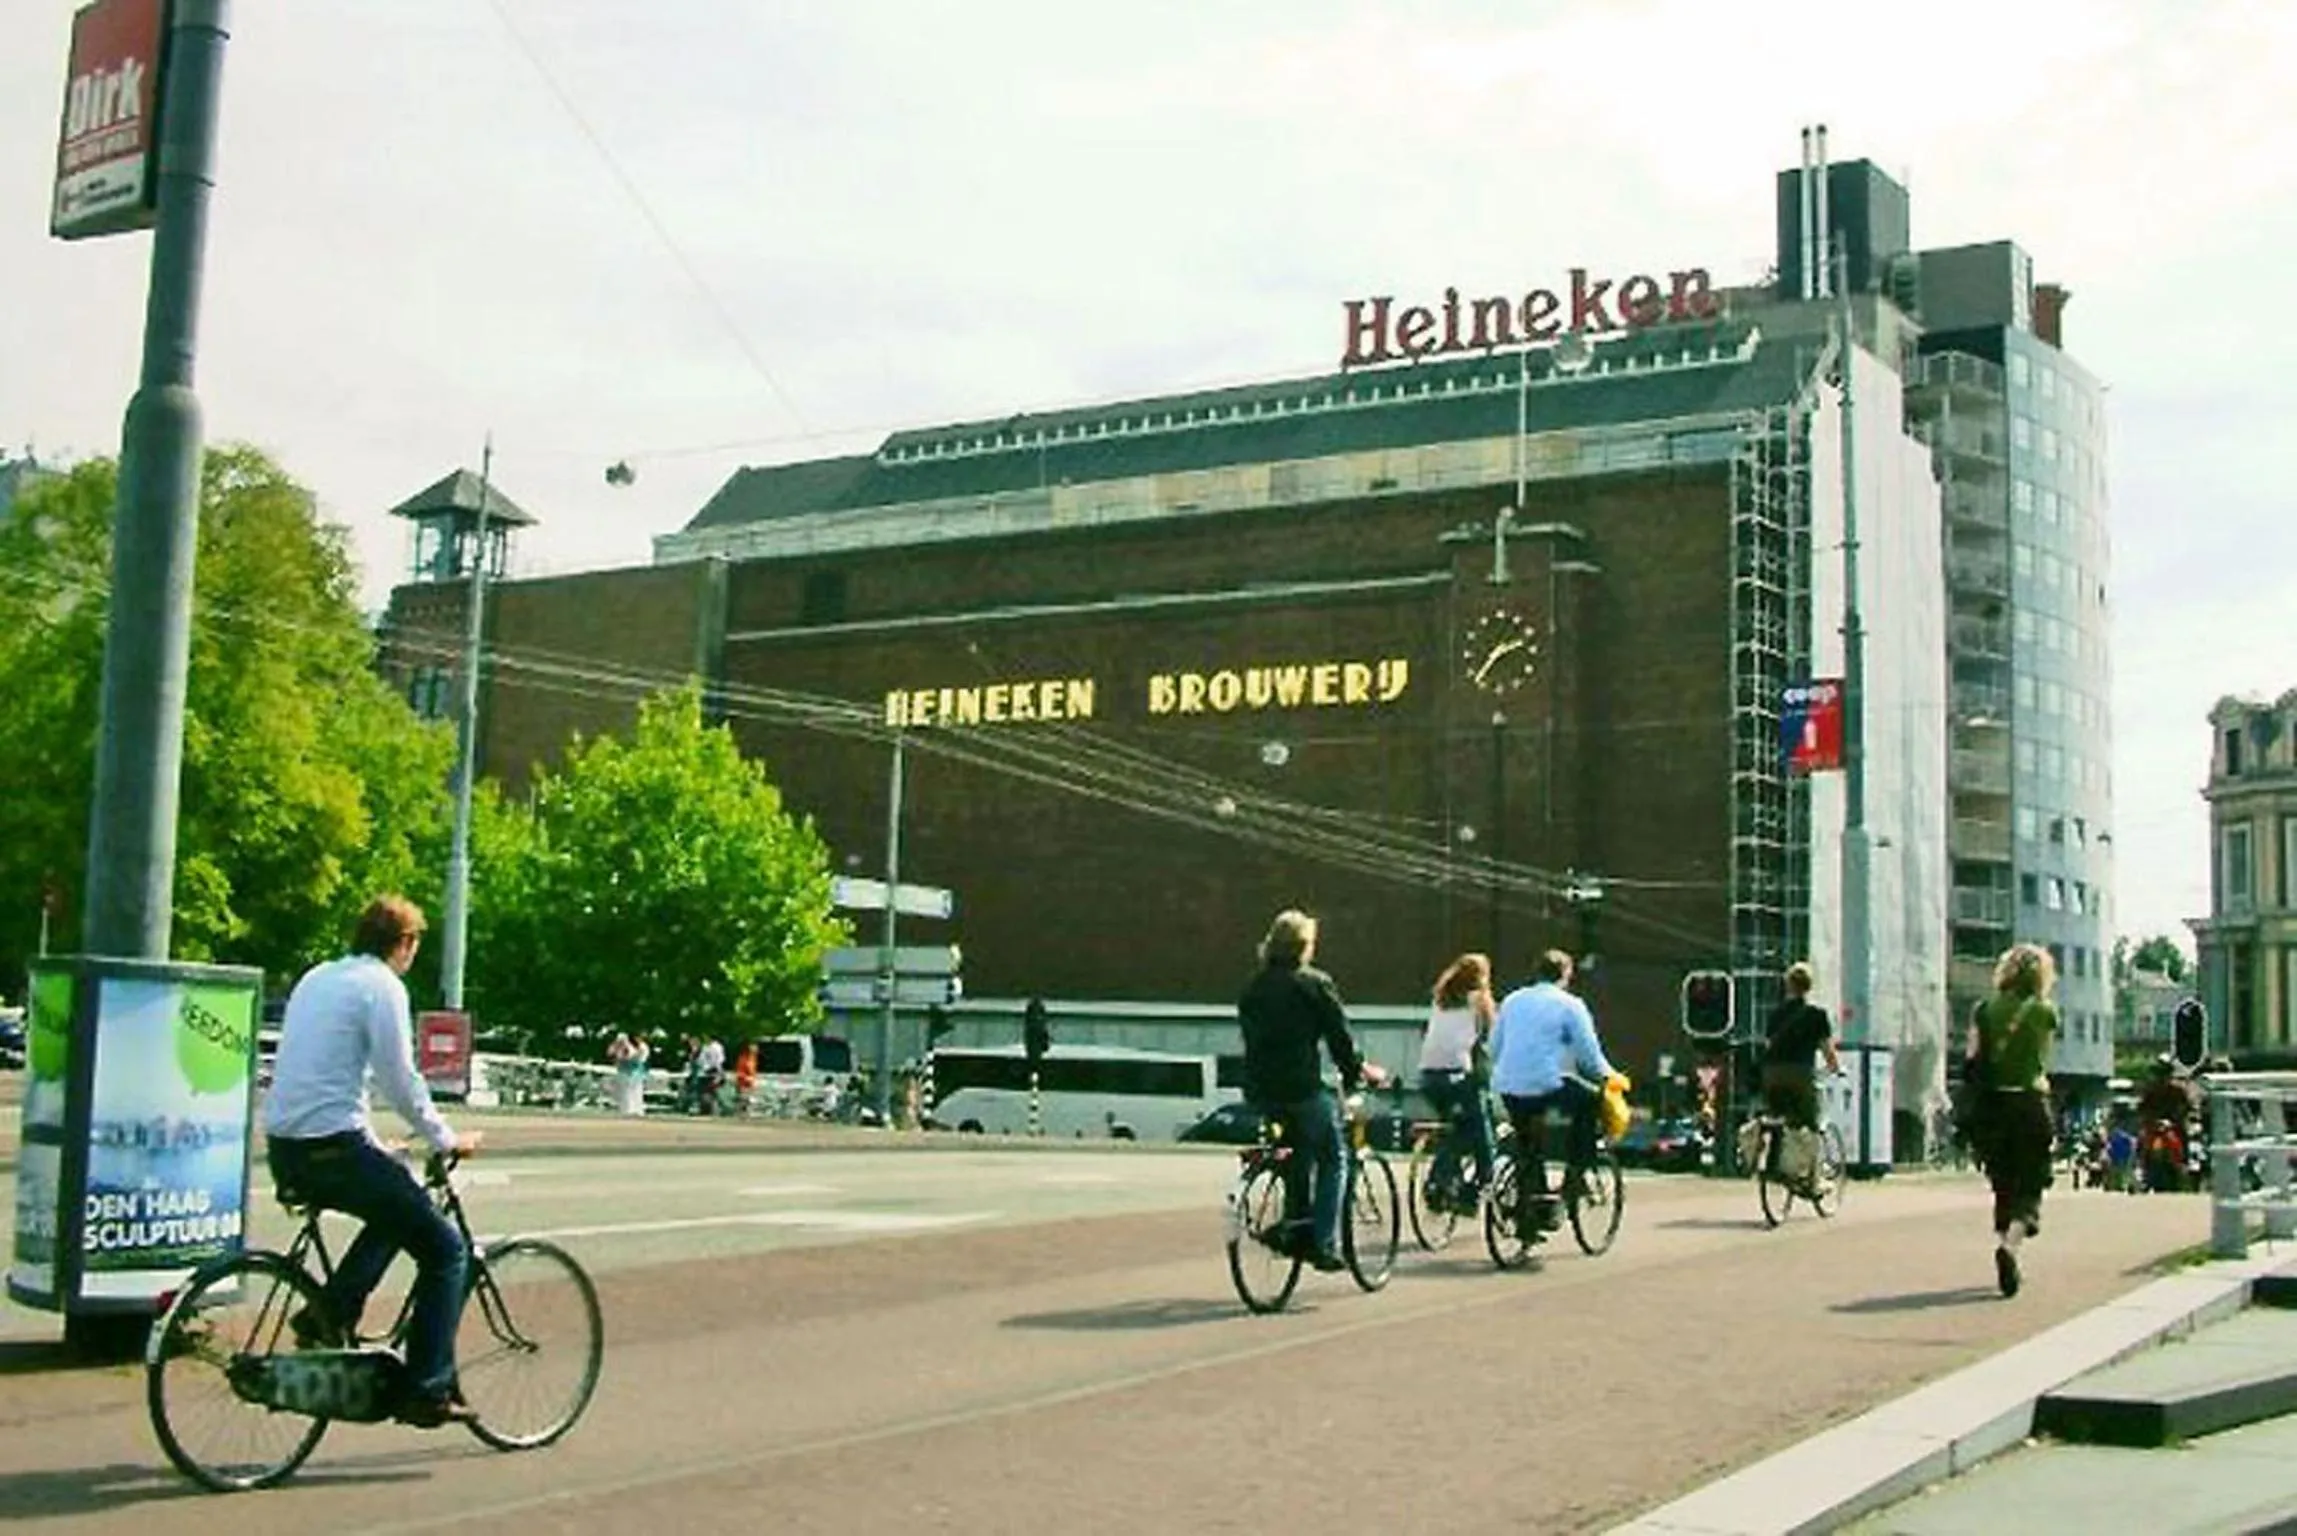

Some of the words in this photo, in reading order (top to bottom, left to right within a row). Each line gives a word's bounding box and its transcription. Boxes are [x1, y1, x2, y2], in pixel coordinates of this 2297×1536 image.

[65, 56, 146, 141] Dirk
[1342, 267, 1719, 367] Heineken
[886, 677, 1094, 728] HEINEKEN
[84, 1193, 138, 1221] DEN
